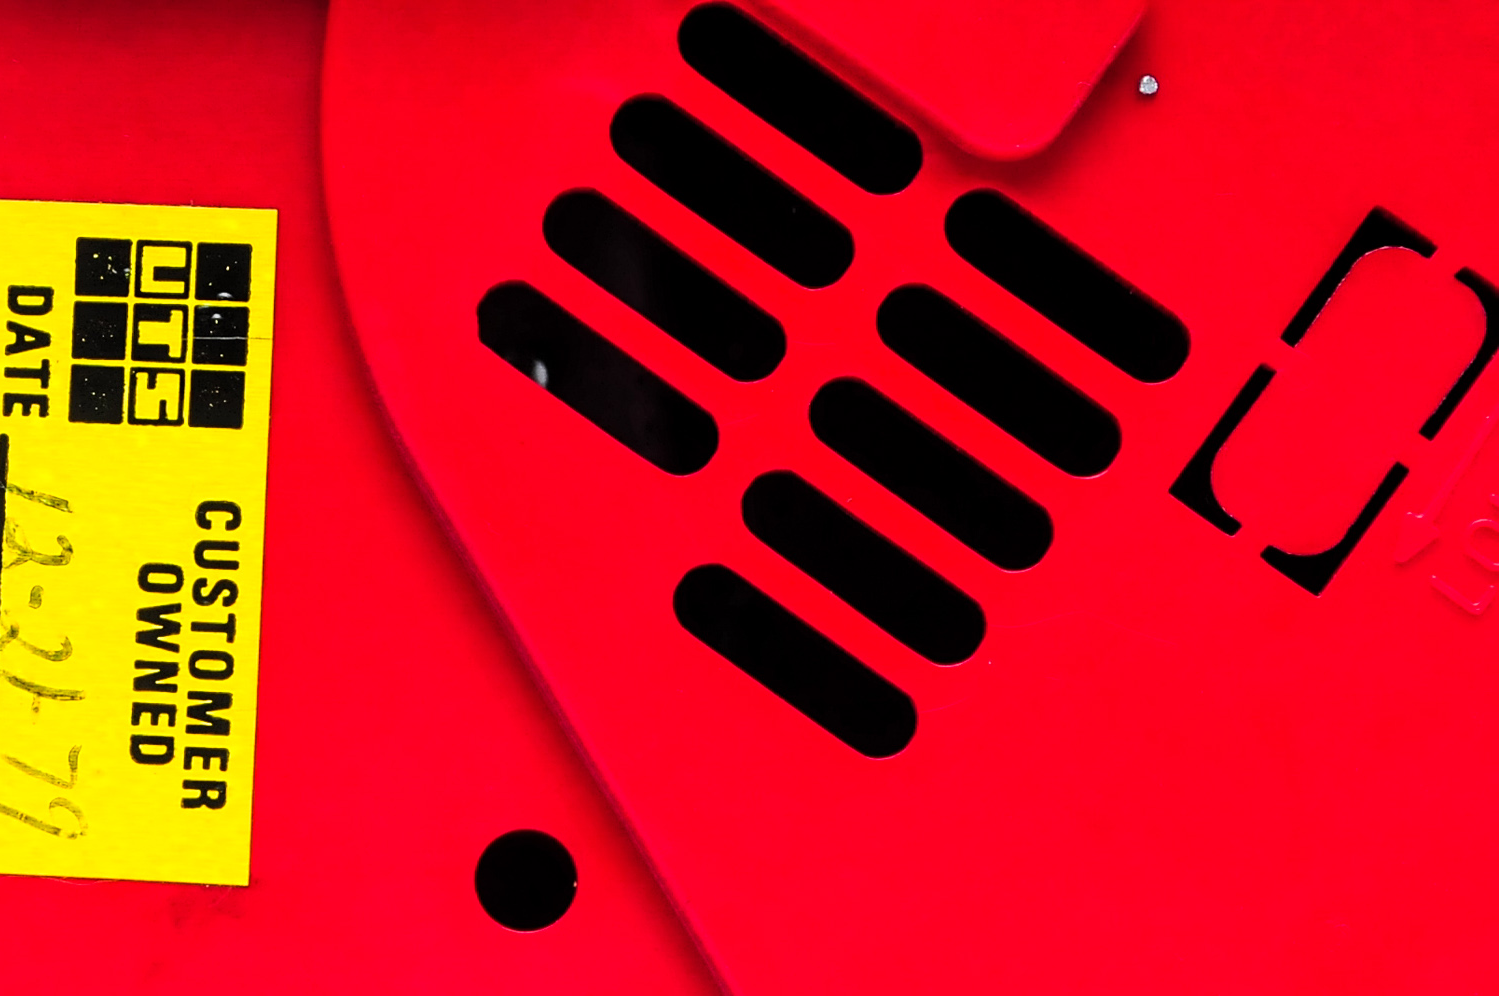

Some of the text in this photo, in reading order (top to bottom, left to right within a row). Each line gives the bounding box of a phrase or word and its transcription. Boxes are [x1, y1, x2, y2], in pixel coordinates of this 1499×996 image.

[2, 284, 55, 418] DATE
[127, 239, 193, 427] UTS
[128, 562, 184, 766] OWNED
[180, 500, 242, 810] CUSTOMER
